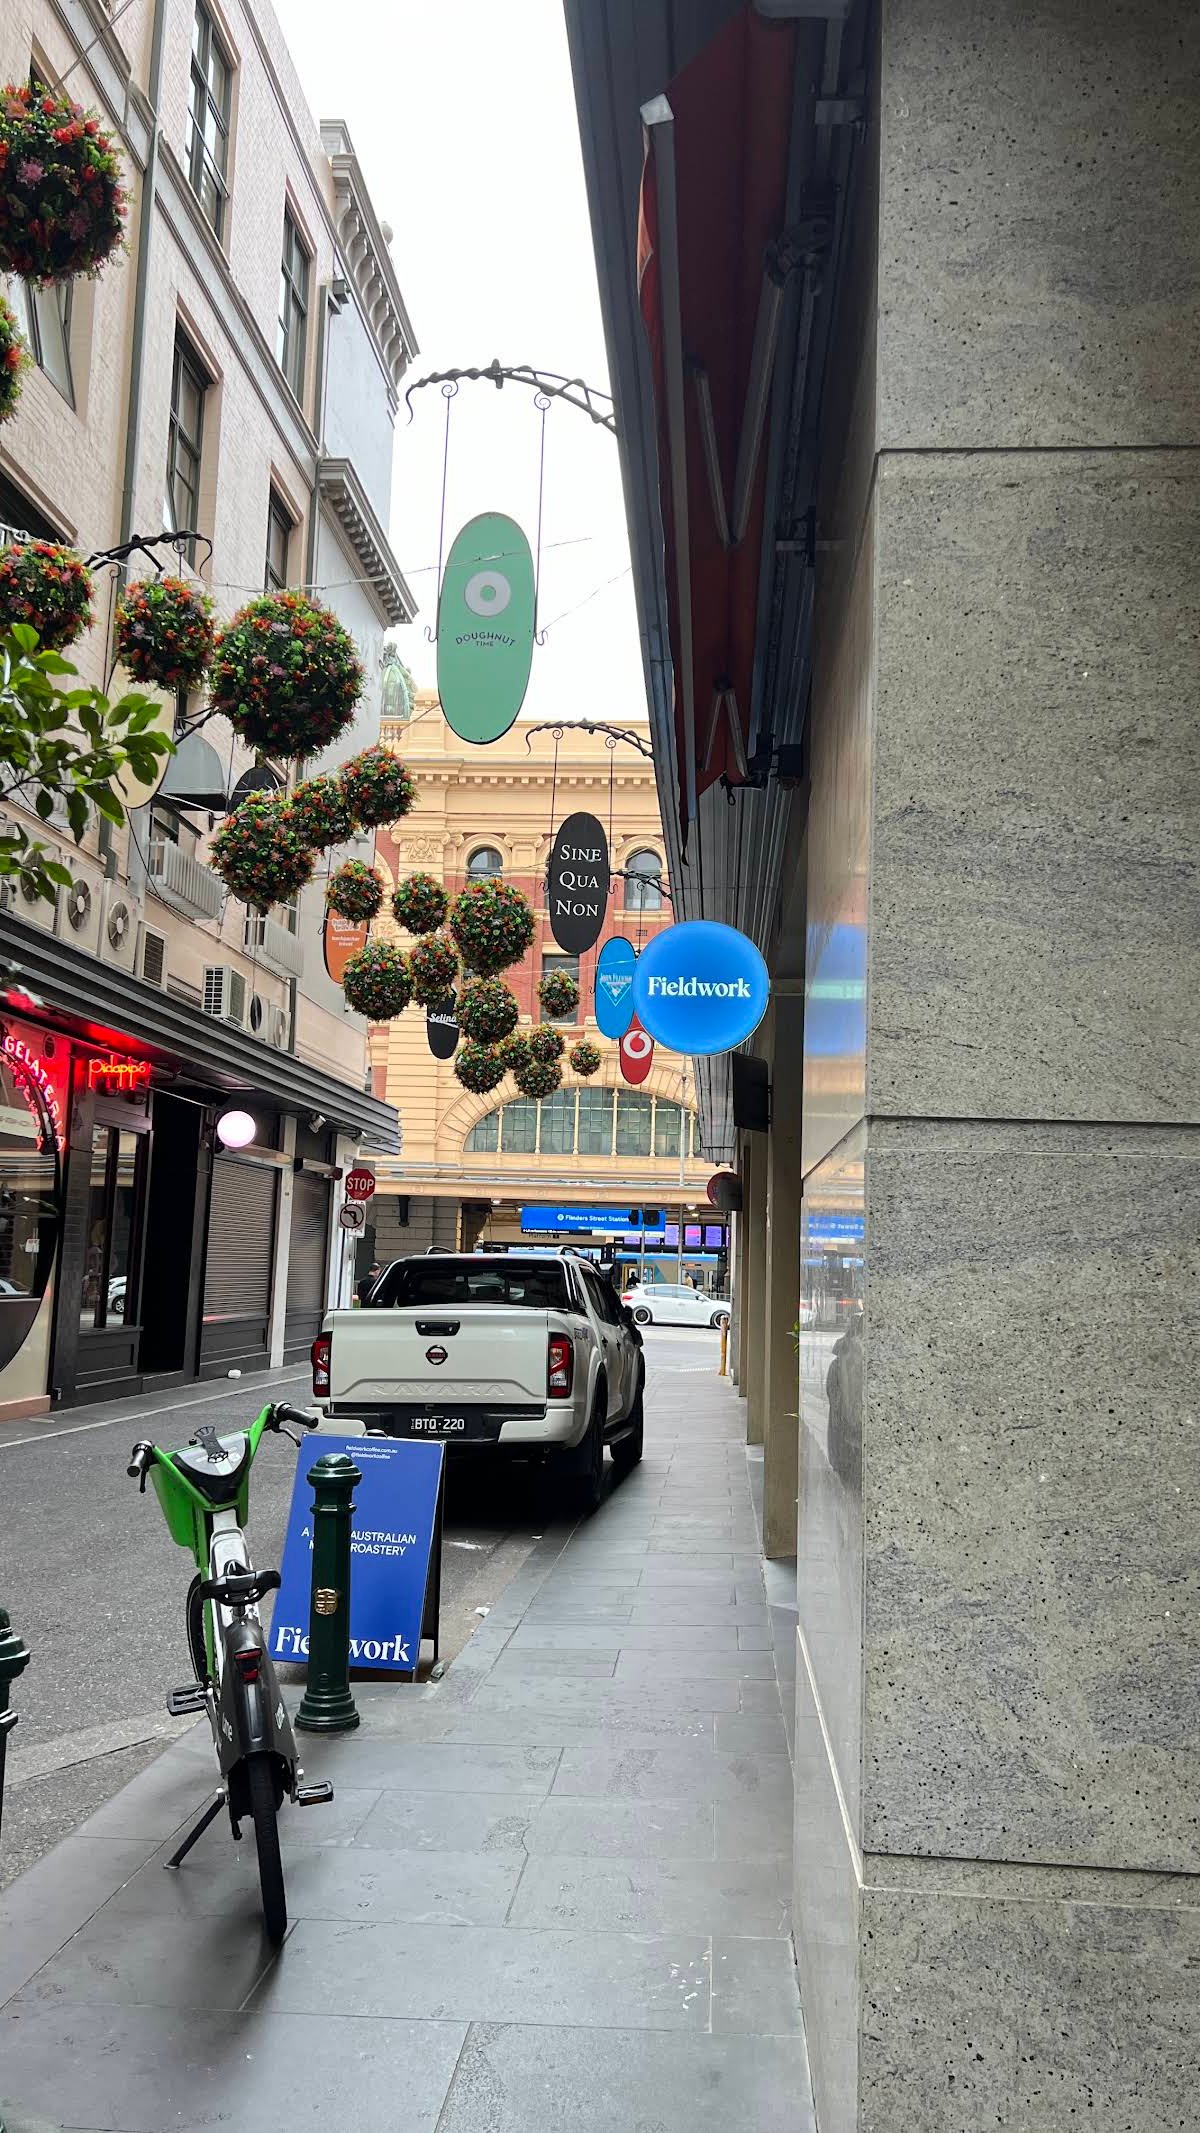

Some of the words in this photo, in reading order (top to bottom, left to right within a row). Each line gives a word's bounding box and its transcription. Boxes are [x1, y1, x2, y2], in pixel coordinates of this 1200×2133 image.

[456, 631, 515, 646] DOUGHNUT
[560, 844, 602, 862] SINE
[559, 871, 599, 891] QUA
[556, 899, 599, 917] NON
[648, 976, 751, 998] Fieldwork
[4, 1035, 66, 1152] GELATERIA
[346, 1176, 375, 1192] STOP
[589, 1214, 607, 1222] Street
[608, 1215, 630, 1223] Station
[371, 1384, 505, 1396] NAVARA
[300, 1527, 310, 1537] A
[350, 1530, 417, 1545] AUSTRALIAN
[350, 1543, 407, 1557] ROASTERY
[275, 1626, 410, 1662] Fiework
